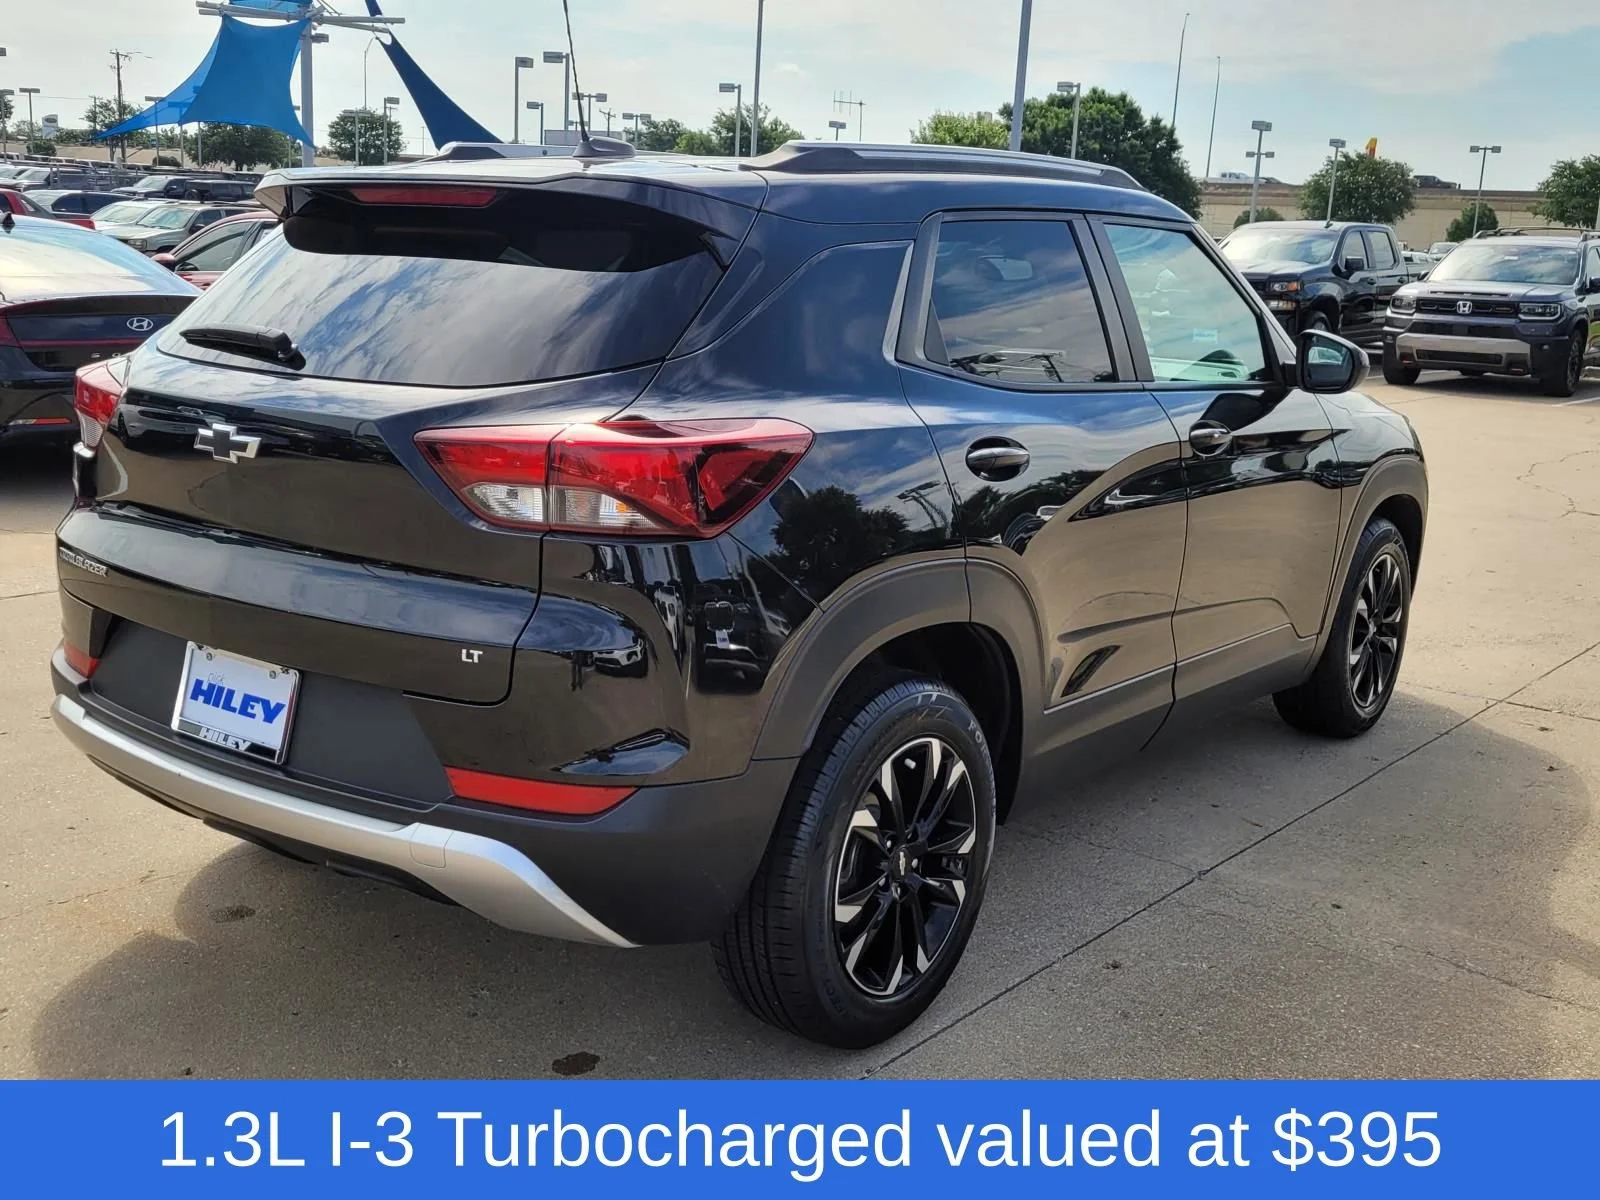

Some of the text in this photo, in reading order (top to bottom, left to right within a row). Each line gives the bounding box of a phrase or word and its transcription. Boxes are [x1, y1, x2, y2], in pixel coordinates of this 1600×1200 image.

[461, 648, 483, 663] LT
[190, 678, 286, 724] HILEY
[200, 726, 251, 750] HILEY
